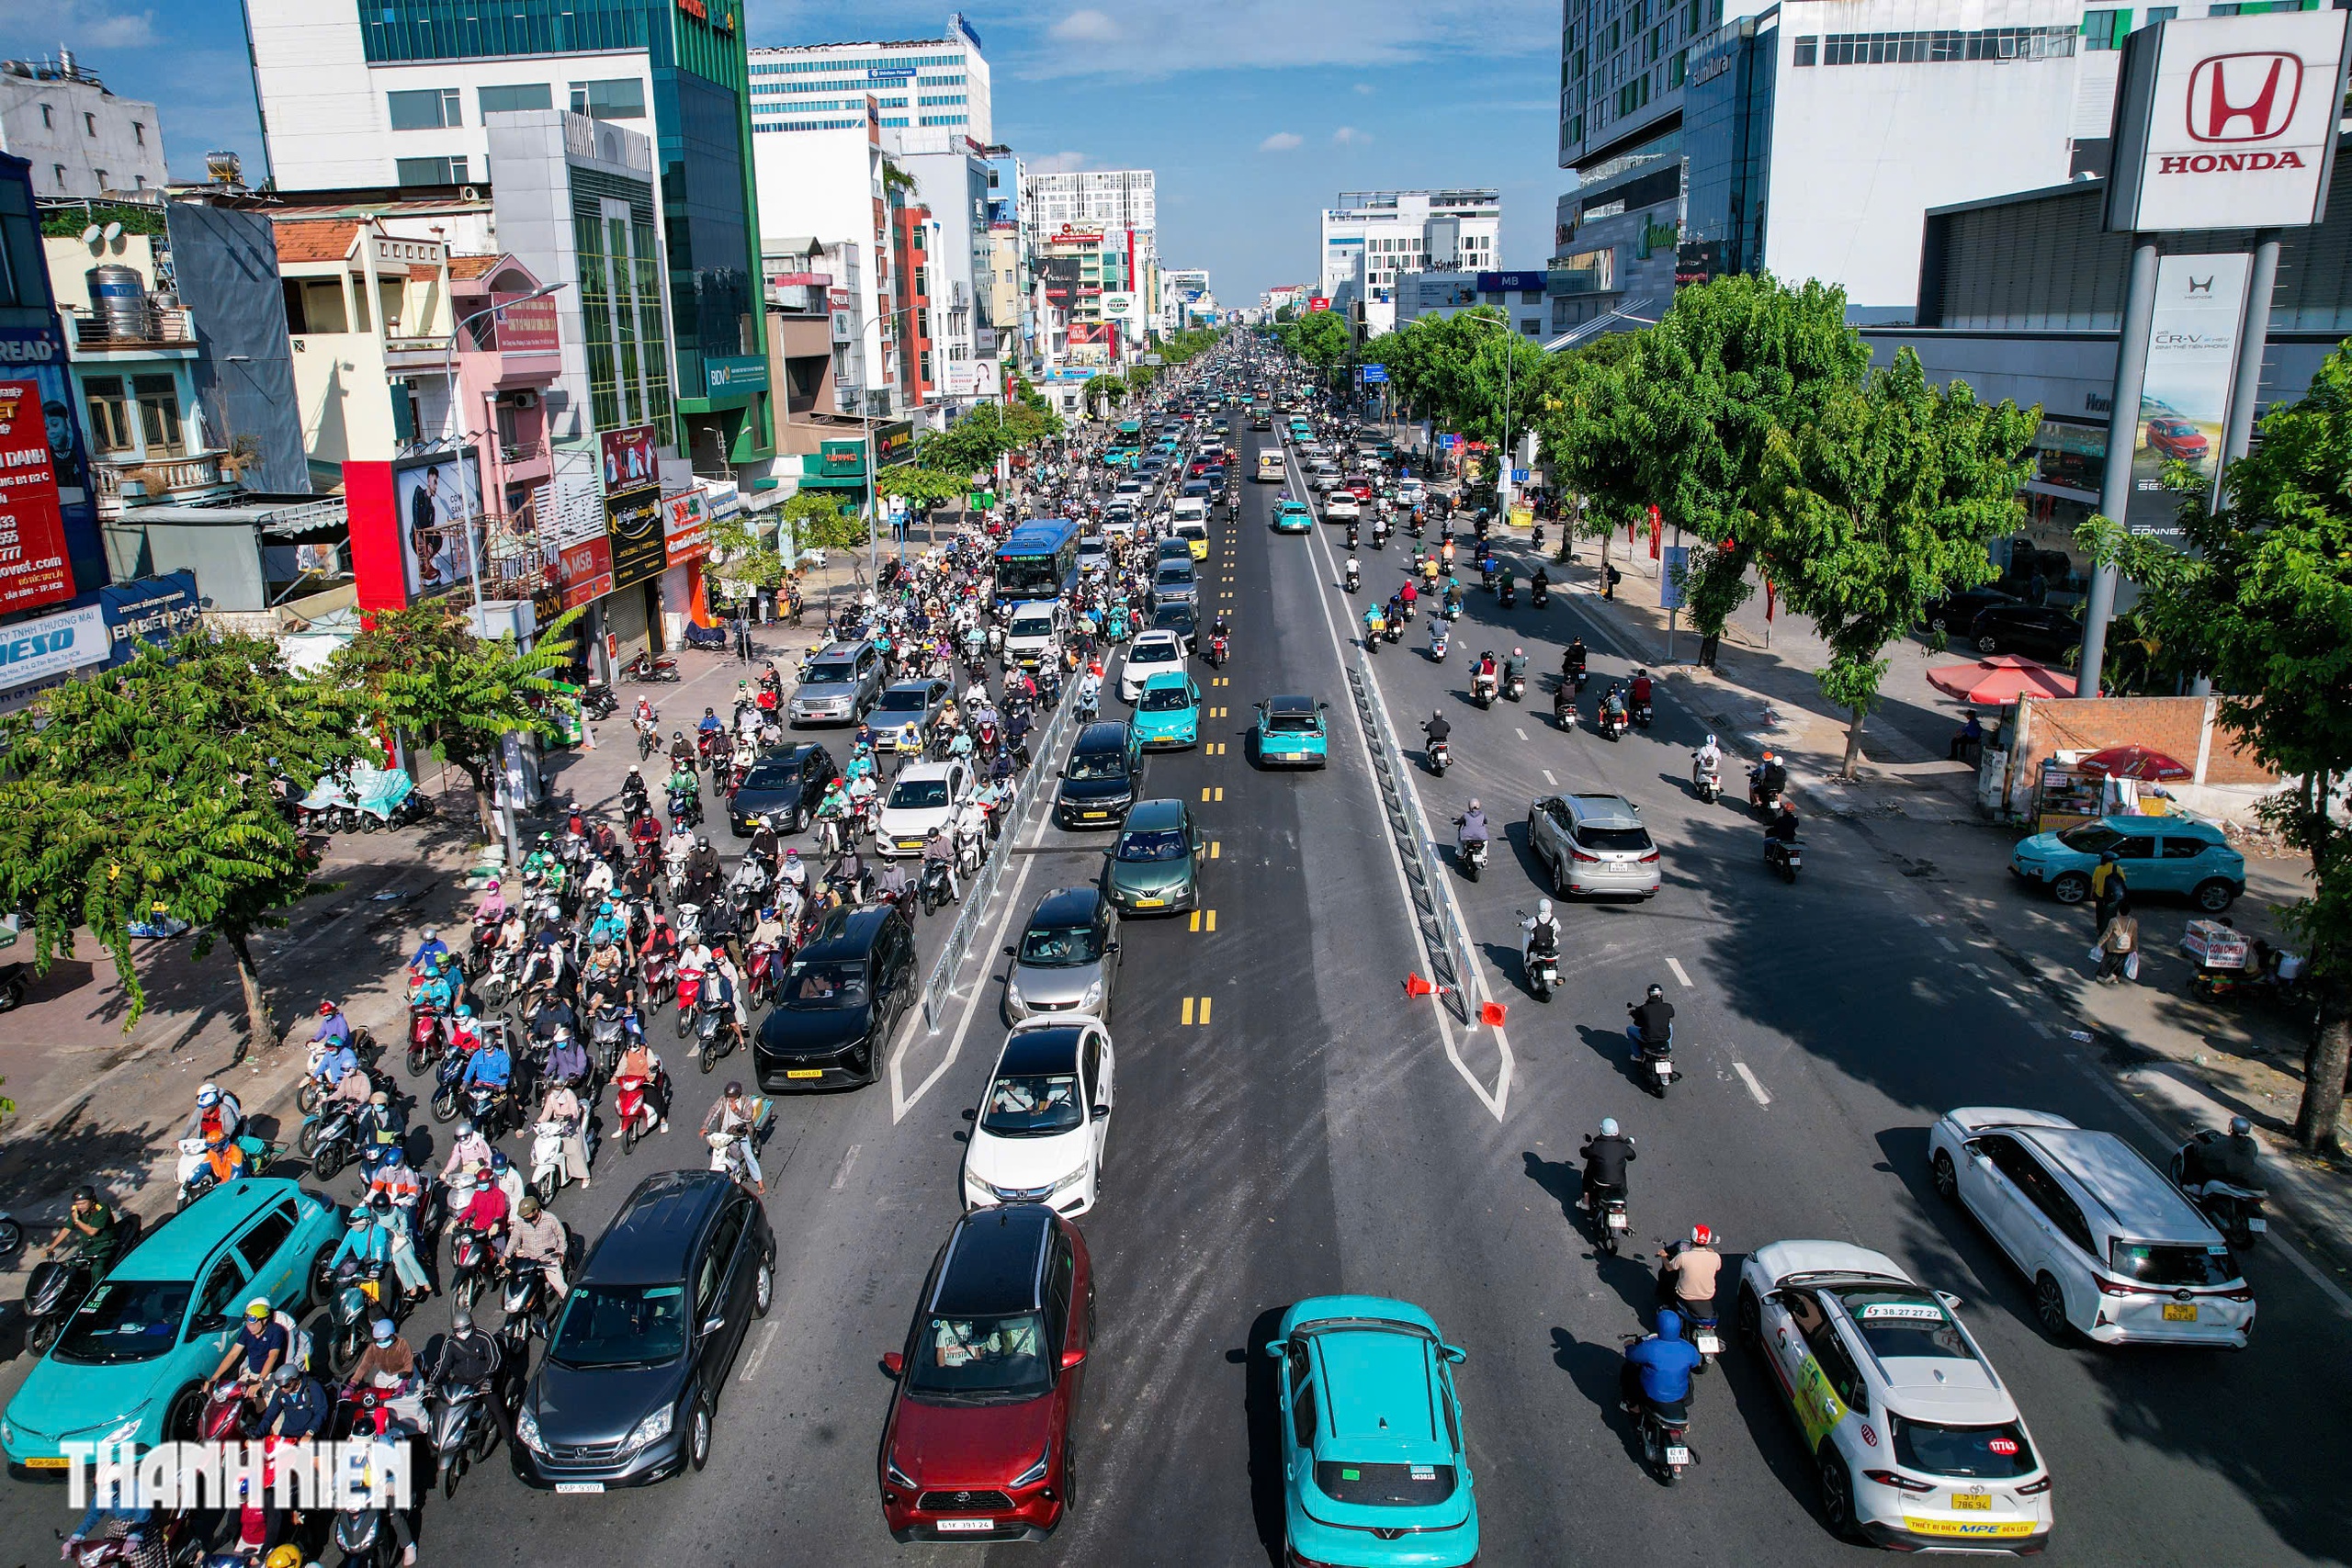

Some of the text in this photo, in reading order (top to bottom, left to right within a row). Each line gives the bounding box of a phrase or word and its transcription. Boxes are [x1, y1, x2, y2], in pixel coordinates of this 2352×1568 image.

[2159, 152, 2306, 175] HONDA
[1447, 260, 1463, 269] MB
[1502, 276, 1519, 286] MB
[2155, 334, 2202, 344] CR-V
[6, 448, 47, 468] DANH
[16, 475, 28, 486] B1
[29, 473, 41, 484] B2
[42, 471, 50, 482] C
[571, 551, 593, 573] MSB
[12, 625, 37, 639] TNHH
[40, 615, 78, 631] THƯƠNG
[79, 610, 95, 624] MẠI
[2159, 767, 2184, 775] STING
[1989, 1440, 2017, 1451] 17743
[1958, 1501, 1987, 1509] 786.94
[1912, 1520, 1929, 1529] THIẾT
[1960, 1524, 2000, 1533] MPE
